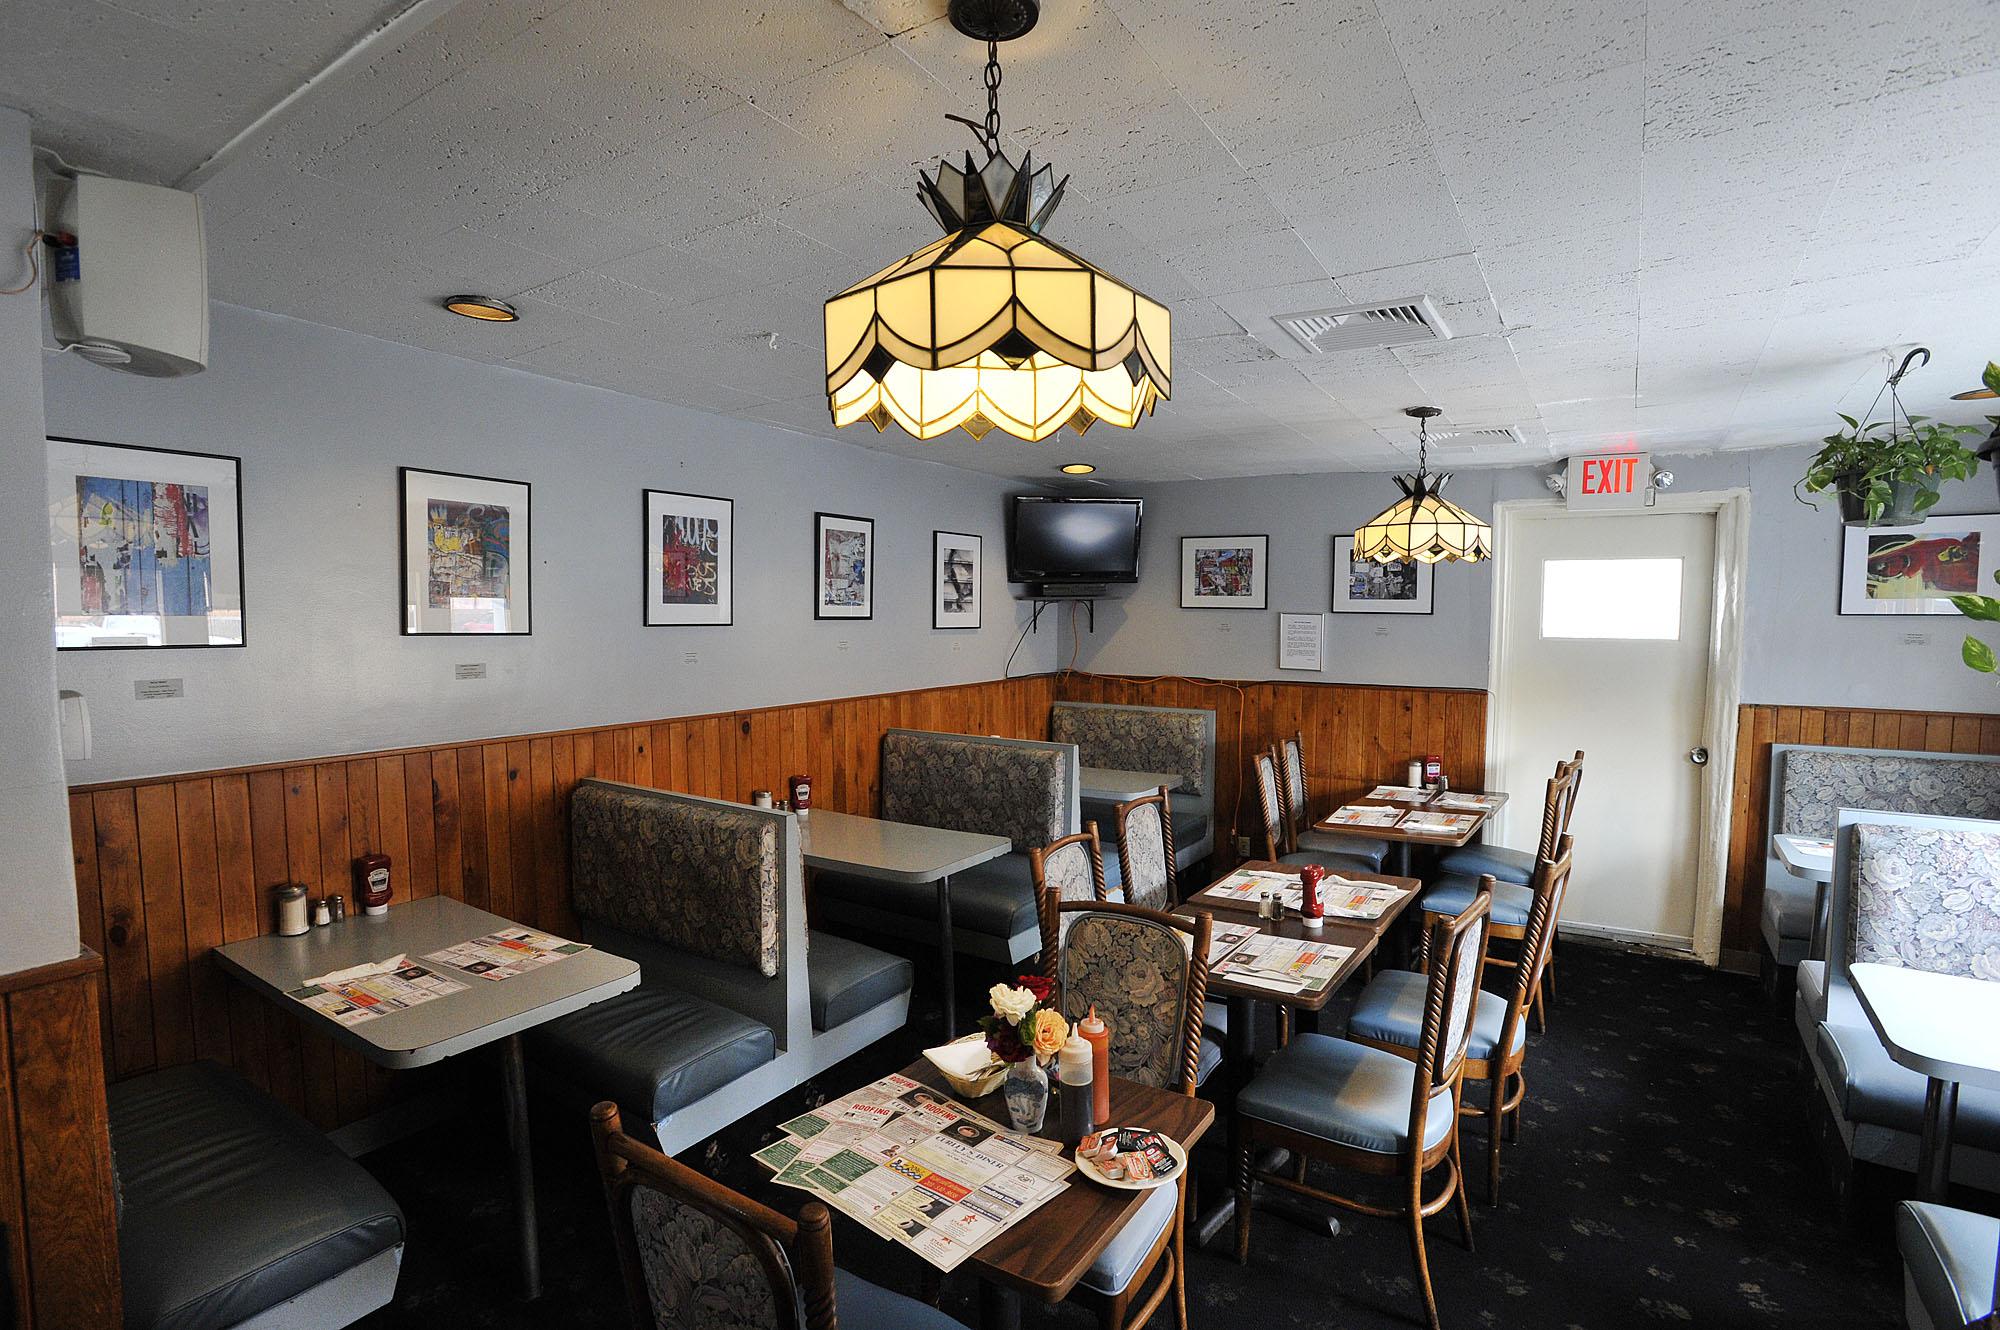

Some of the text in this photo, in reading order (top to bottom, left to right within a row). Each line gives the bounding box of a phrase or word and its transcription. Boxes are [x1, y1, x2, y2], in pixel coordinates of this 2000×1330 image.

[1582, 458, 1638, 494] EXIT
[851, 1103, 891, 1116] ROOFING
[923, 1102, 959, 1121] ROOFING
[975, 1153, 1004, 1169] DINER
